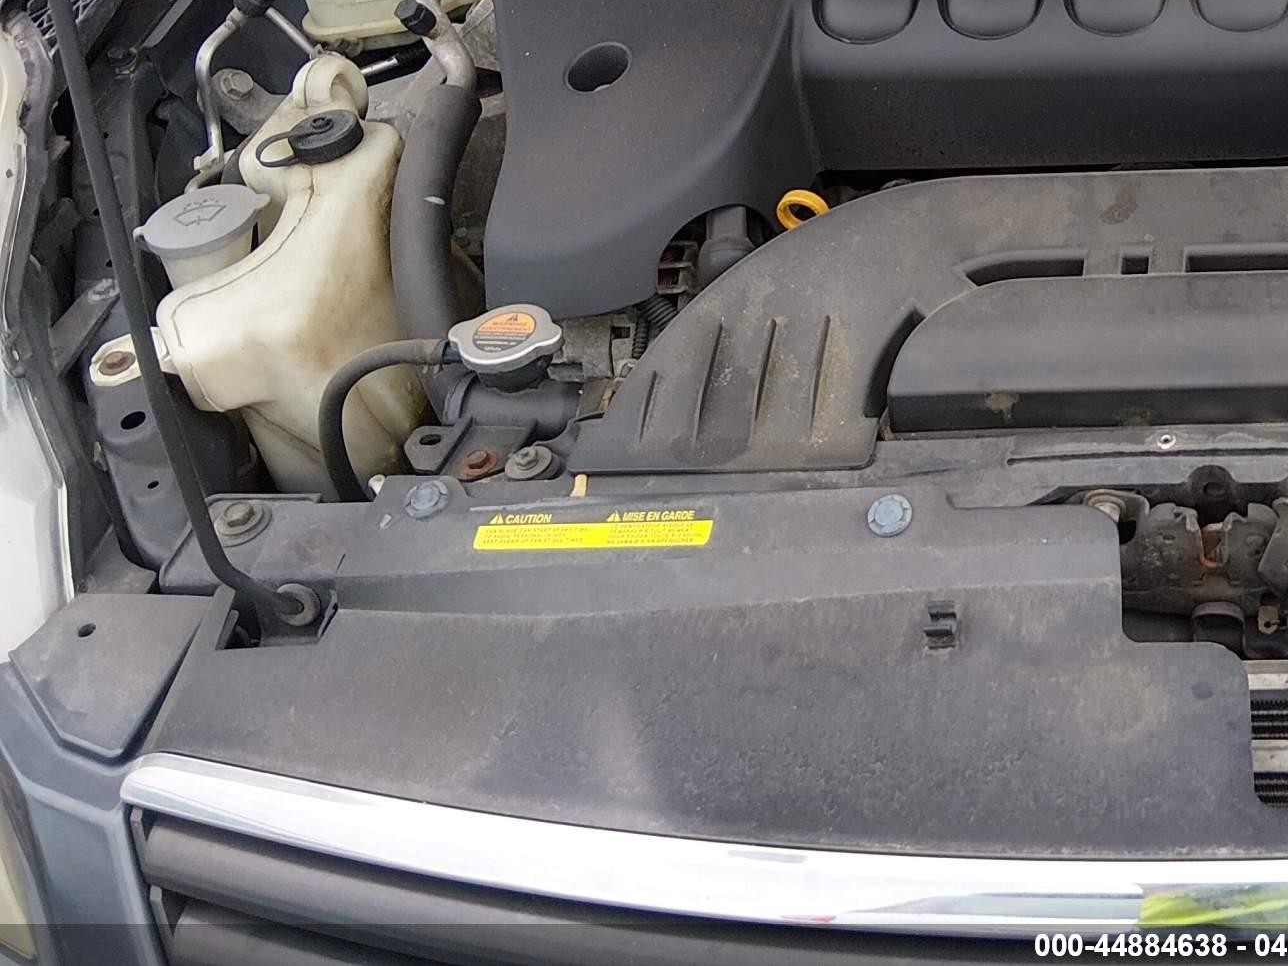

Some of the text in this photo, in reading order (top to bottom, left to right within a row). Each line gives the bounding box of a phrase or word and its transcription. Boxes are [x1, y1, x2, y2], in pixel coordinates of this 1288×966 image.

[504, 513, 553, 524] CAUTION
[622, 509, 696, 522] MISE EN GARDE
